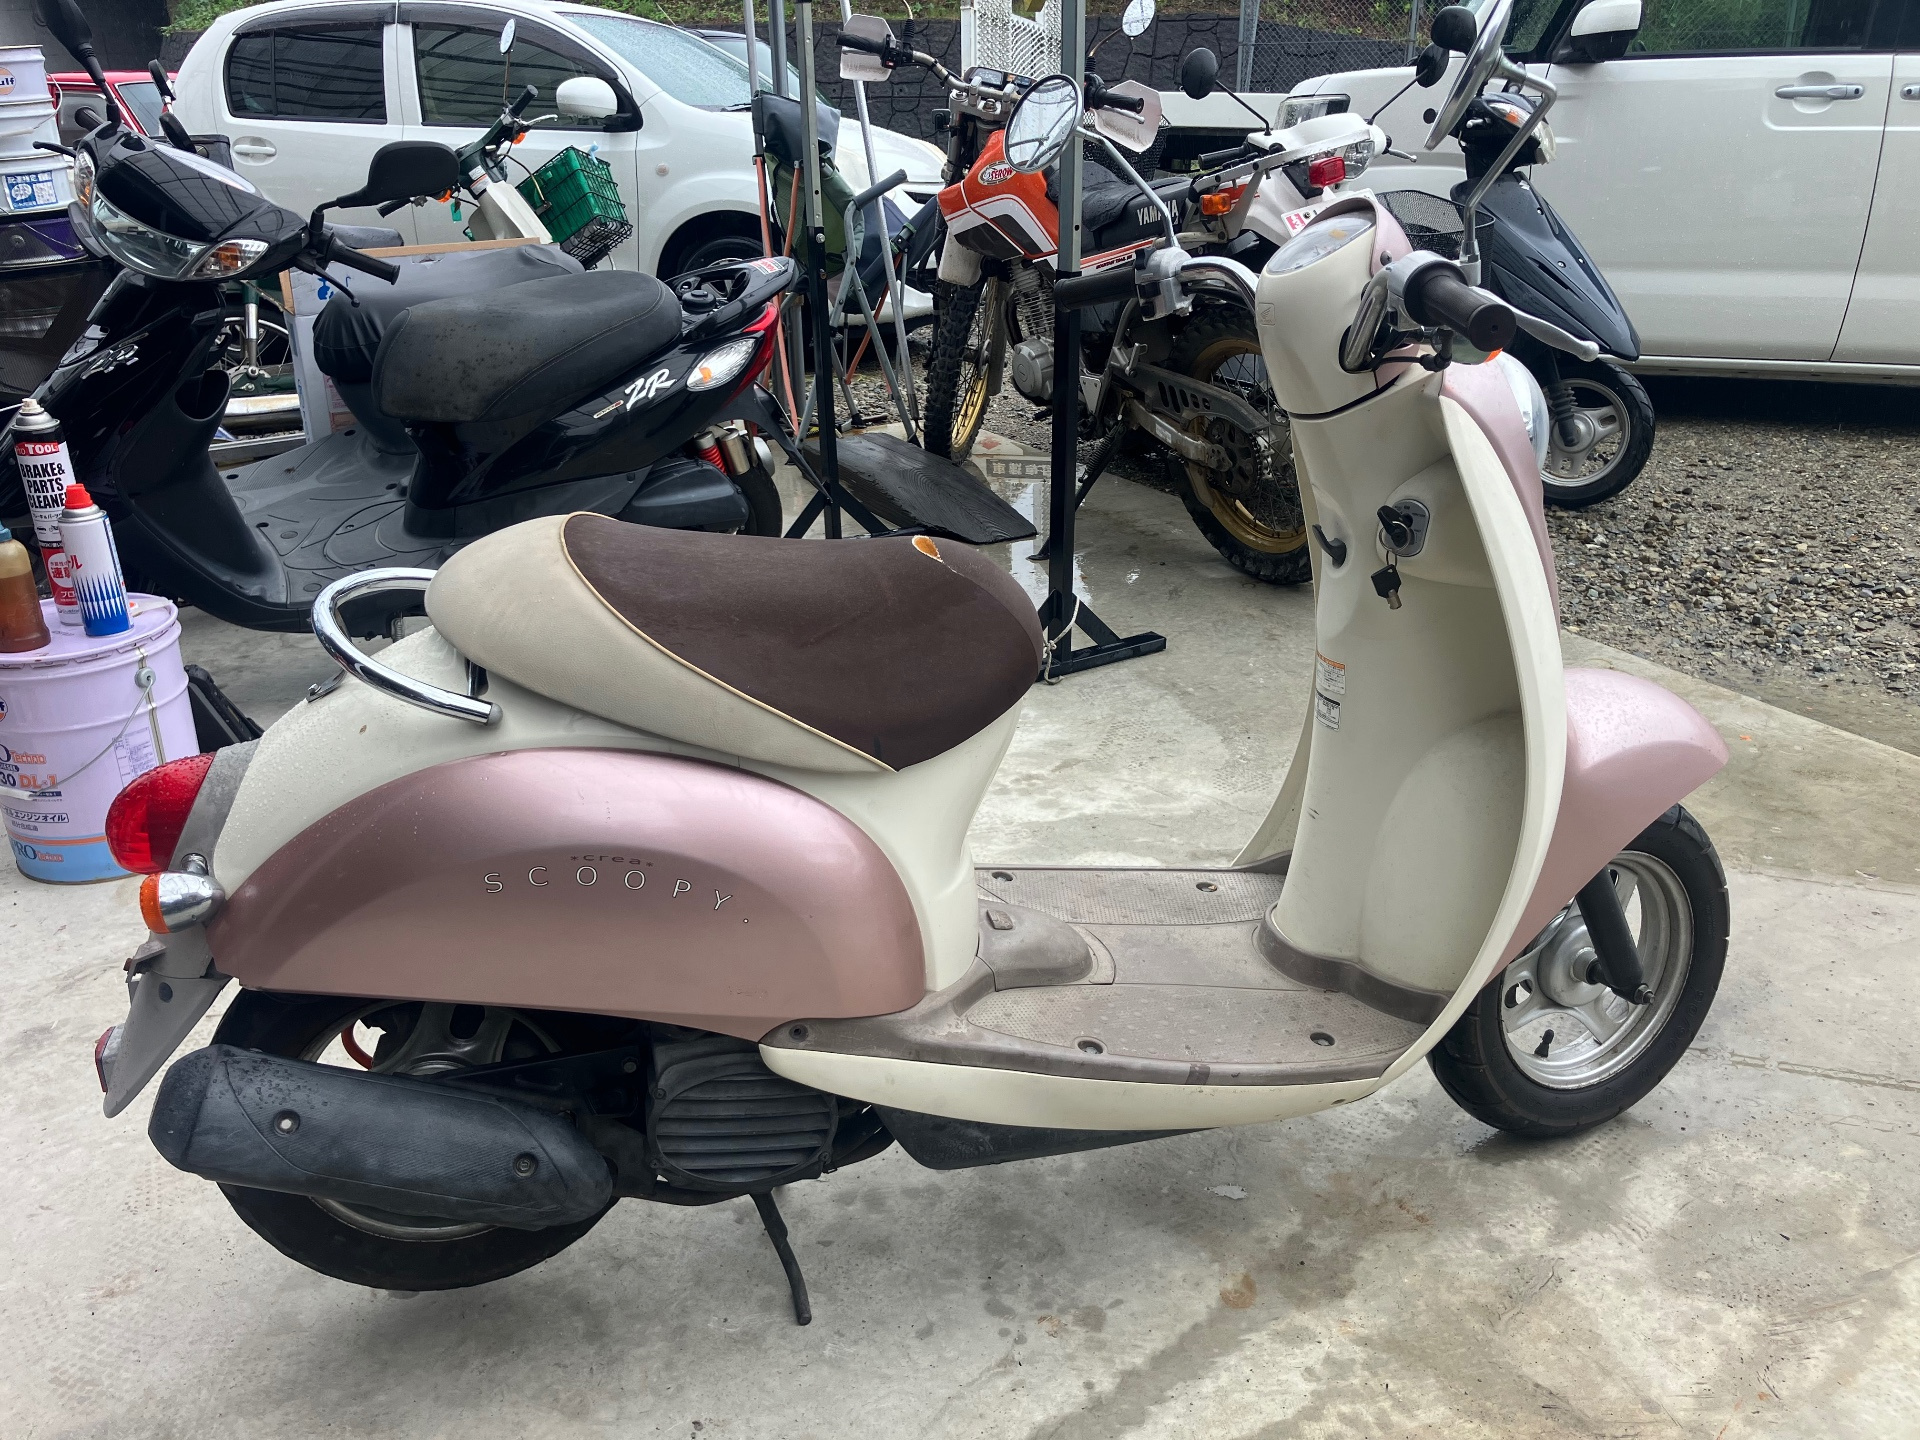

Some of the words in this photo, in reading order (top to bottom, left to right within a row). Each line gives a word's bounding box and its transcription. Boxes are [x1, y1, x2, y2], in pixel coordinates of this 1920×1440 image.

[624, 368, 677, 411] ZR
[26, 477, 64, 494] PARTS
[27, 492, 68, 509] CLEANE
[18, 773, 58, 790] DL-1
